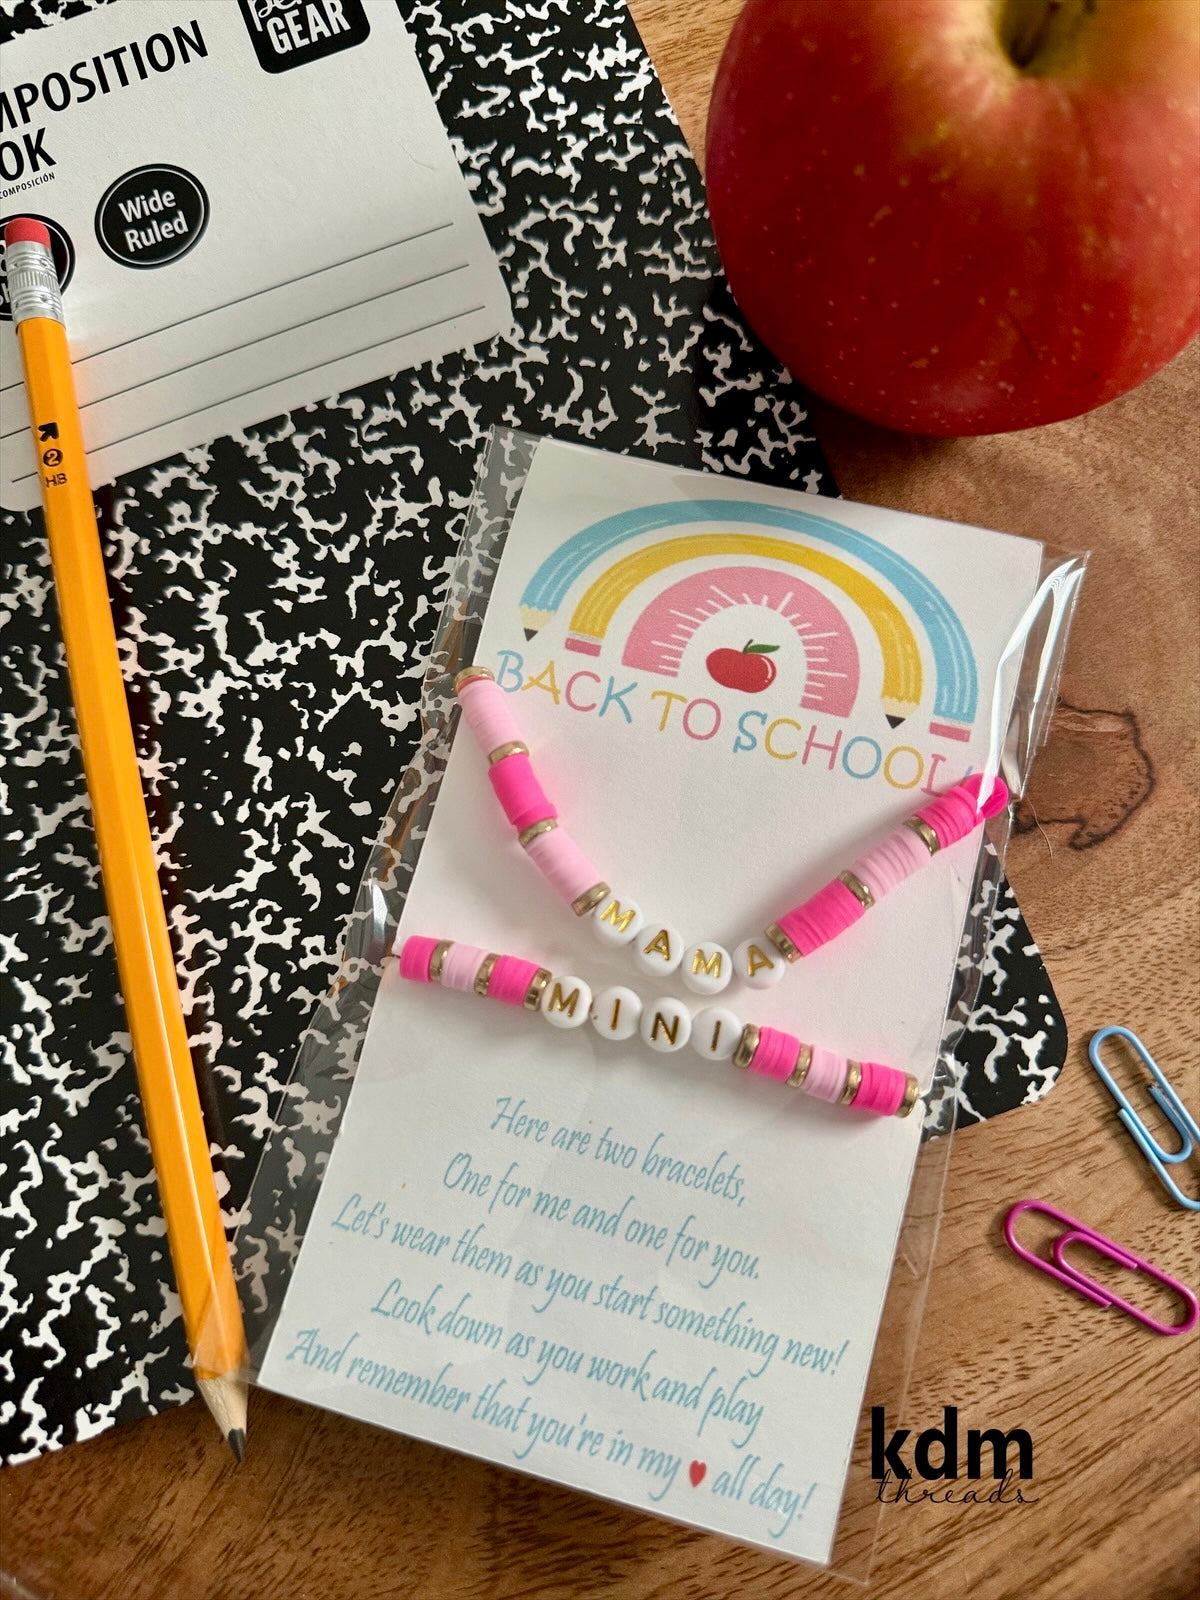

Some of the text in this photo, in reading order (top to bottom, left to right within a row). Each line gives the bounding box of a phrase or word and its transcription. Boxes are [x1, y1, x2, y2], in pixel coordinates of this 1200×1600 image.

[266, 0, 352, 54] GEAR
[118, 189, 176, 223] Wide
[124, 211, 189, 252] Ruled
[45, 473, 67, 488] HB
[497, 650, 973, 797] BACK TO SCHOOL
[600, 900, 774, 977] MAMA
[548, 983, 721, 1051] MINI
[490, 1097, 746, 1206] Here are two bracelets,
[444, 1152, 760, 1289] One for me and one for you.
[331, 1193, 850, 1378] Let's wear them as you start something new!
[371, 1278, 764, 1448] Look down as you work and play
[286, 1328, 817, 1538] And remember that you're in my all day!
